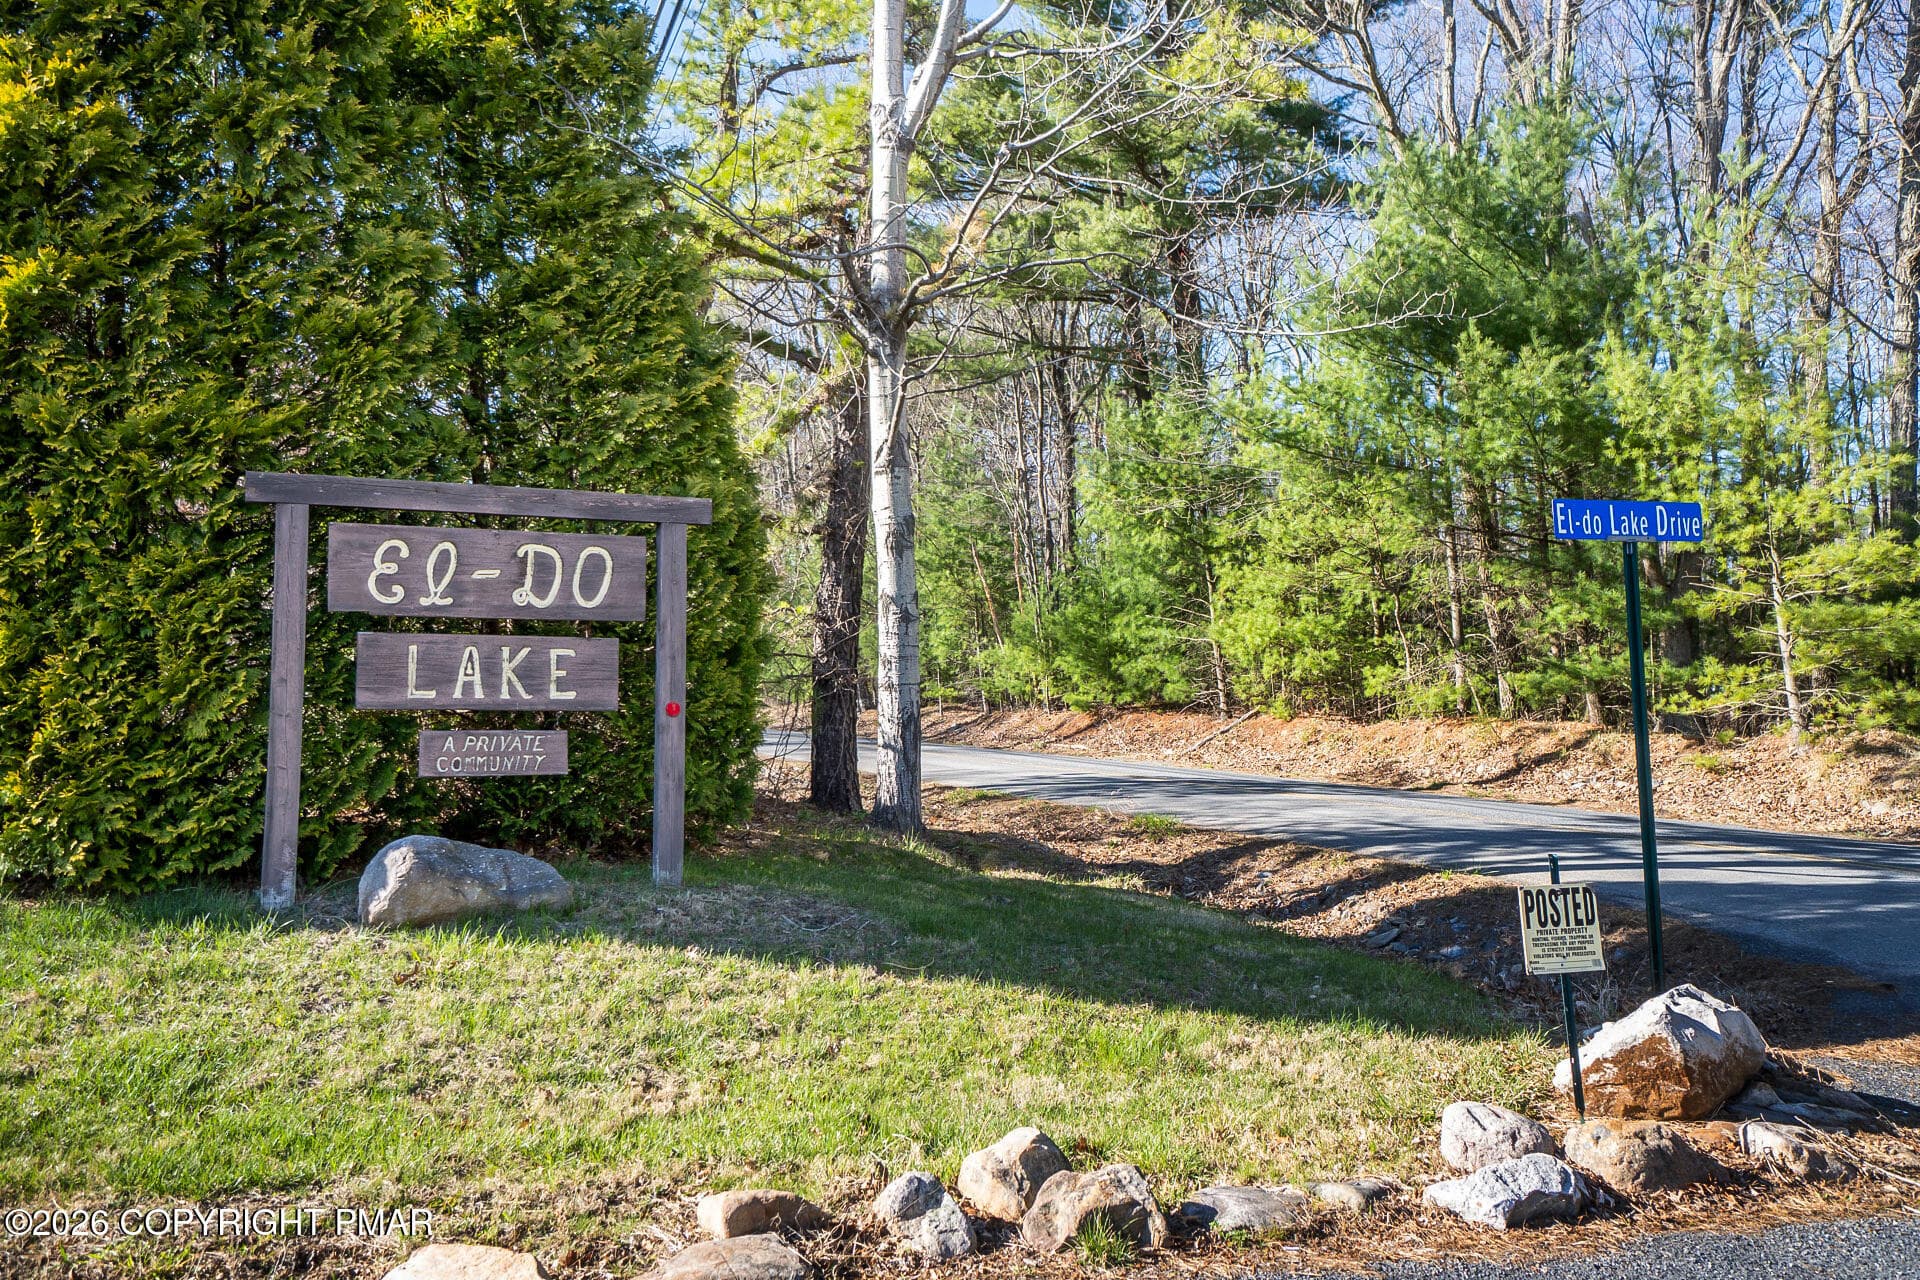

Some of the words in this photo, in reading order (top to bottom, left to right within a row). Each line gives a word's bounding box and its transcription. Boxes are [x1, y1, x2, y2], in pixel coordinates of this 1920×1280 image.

[1556, 503, 1602, 535] El-do
[1610, 504, 1648, 536] Lake
[1656, 505, 1700, 537] Drive
[407, 644, 577, 700] LAKE
[442, 735, 455, 753] A
[462, 735, 547, 752] PRIVATE
[436, 754, 547, 773] COMMUNITY
[1523, 887, 1596, 929] POSTED
[1536, 928, 1558, 936] PRIVATE
[1560, 927, 1588, 935] PROPERTY
